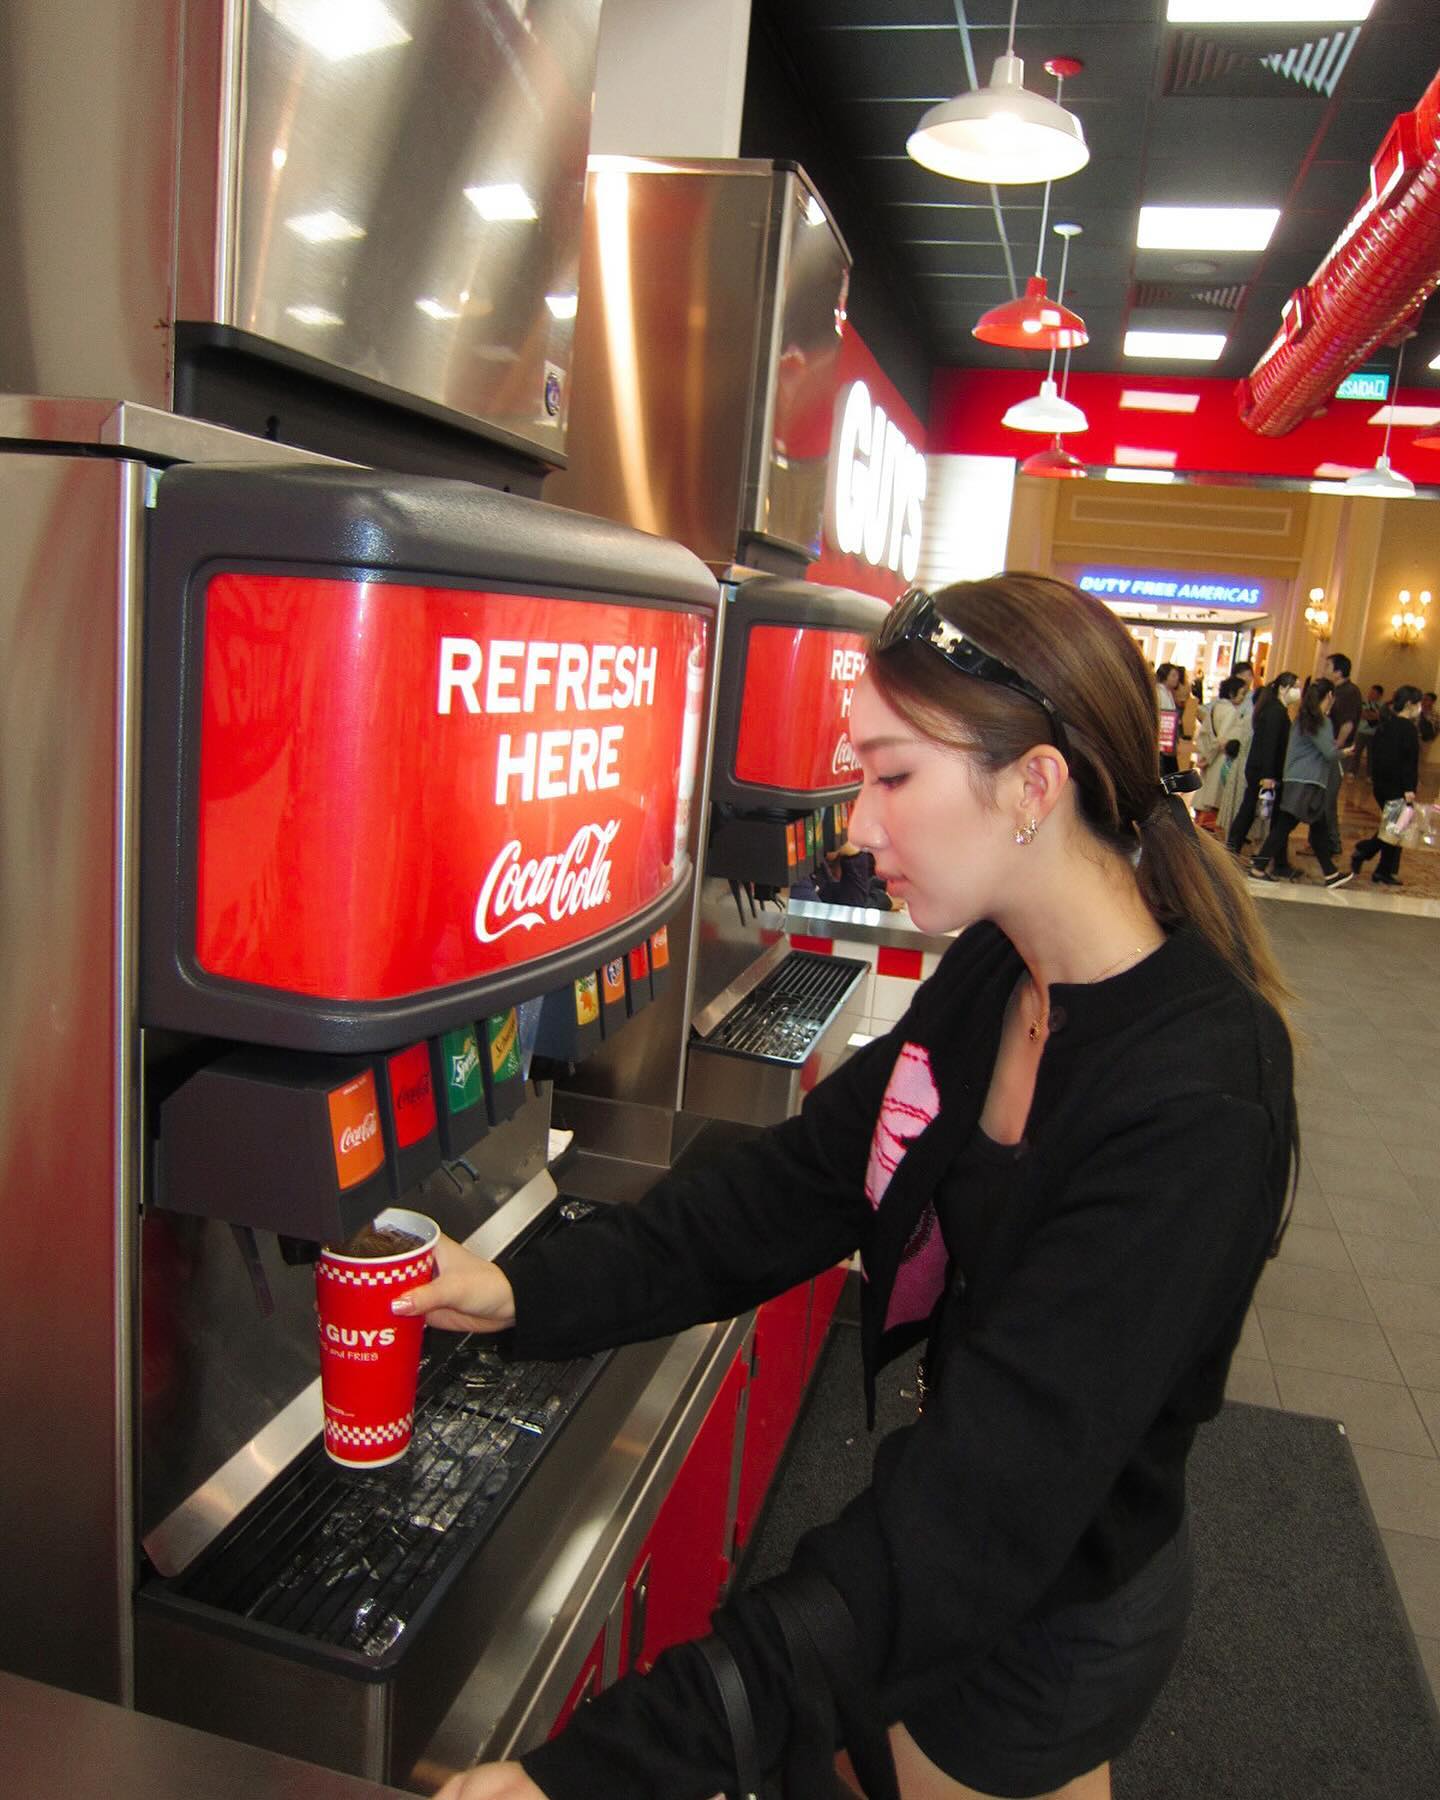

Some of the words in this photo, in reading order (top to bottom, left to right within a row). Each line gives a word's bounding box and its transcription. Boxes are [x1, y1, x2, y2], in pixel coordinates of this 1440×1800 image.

[836, 381, 927, 582] GUYS
[1079, 576, 1131, 594] DUTY
[1131, 580, 1177, 597] FREE
[1177, 584, 1260, 605] AMERICAS
[437, 636, 658, 715] REFRESH
[495, 725, 624, 806] HERE
[473, 819, 622, 944] Coca-Cola
[326, 1323, 396, 1348] GUYS
[347, 1351, 379, 1362] FRIES
